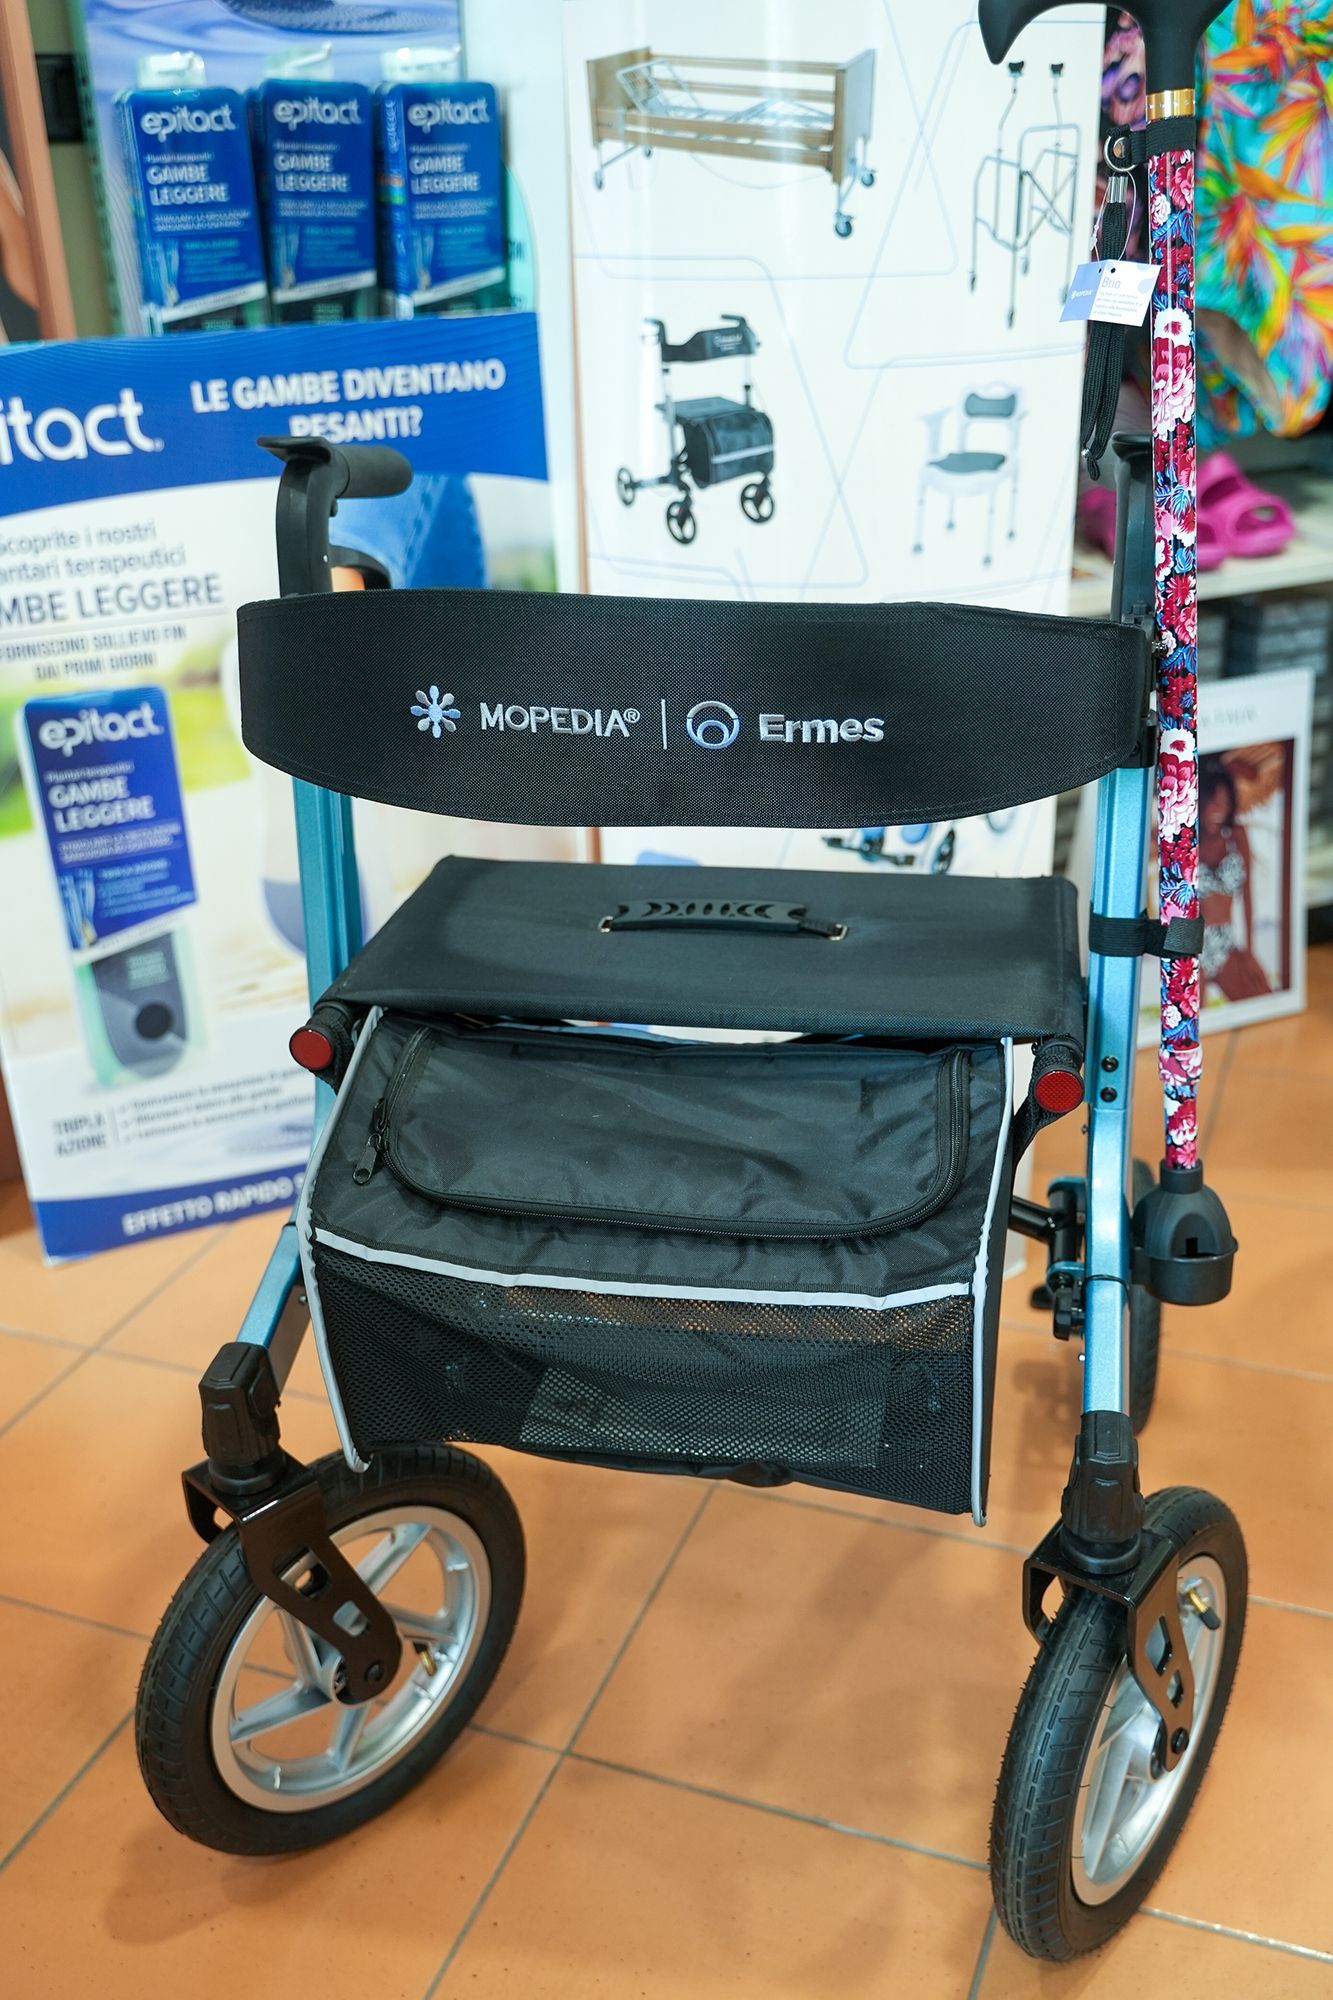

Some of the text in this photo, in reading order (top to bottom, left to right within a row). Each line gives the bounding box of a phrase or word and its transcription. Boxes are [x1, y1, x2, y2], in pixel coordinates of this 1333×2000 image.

[140, 104, 236, 142] epitact
[146, 163, 209, 185] GAMBE
[1101, 276, 1121, 288] Brio
[190, 358, 506, 413] LE GAMBE DIVENTANO
[289, 405, 423, 443] PESANTI?
[97, 519, 156, 543] nostri
[64, 545, 187, 577] terapeutici
[75, 573, 224, 618] LEGGERE
[38, 702, 163, 757] epitact
[759, 713, 885, 743] Ermes
[48, 775, 130, 809] GAMBE
[122, 1196, 214, 1236] EFFETTO
[214, 1176, 293, 1213] RAPIDO
